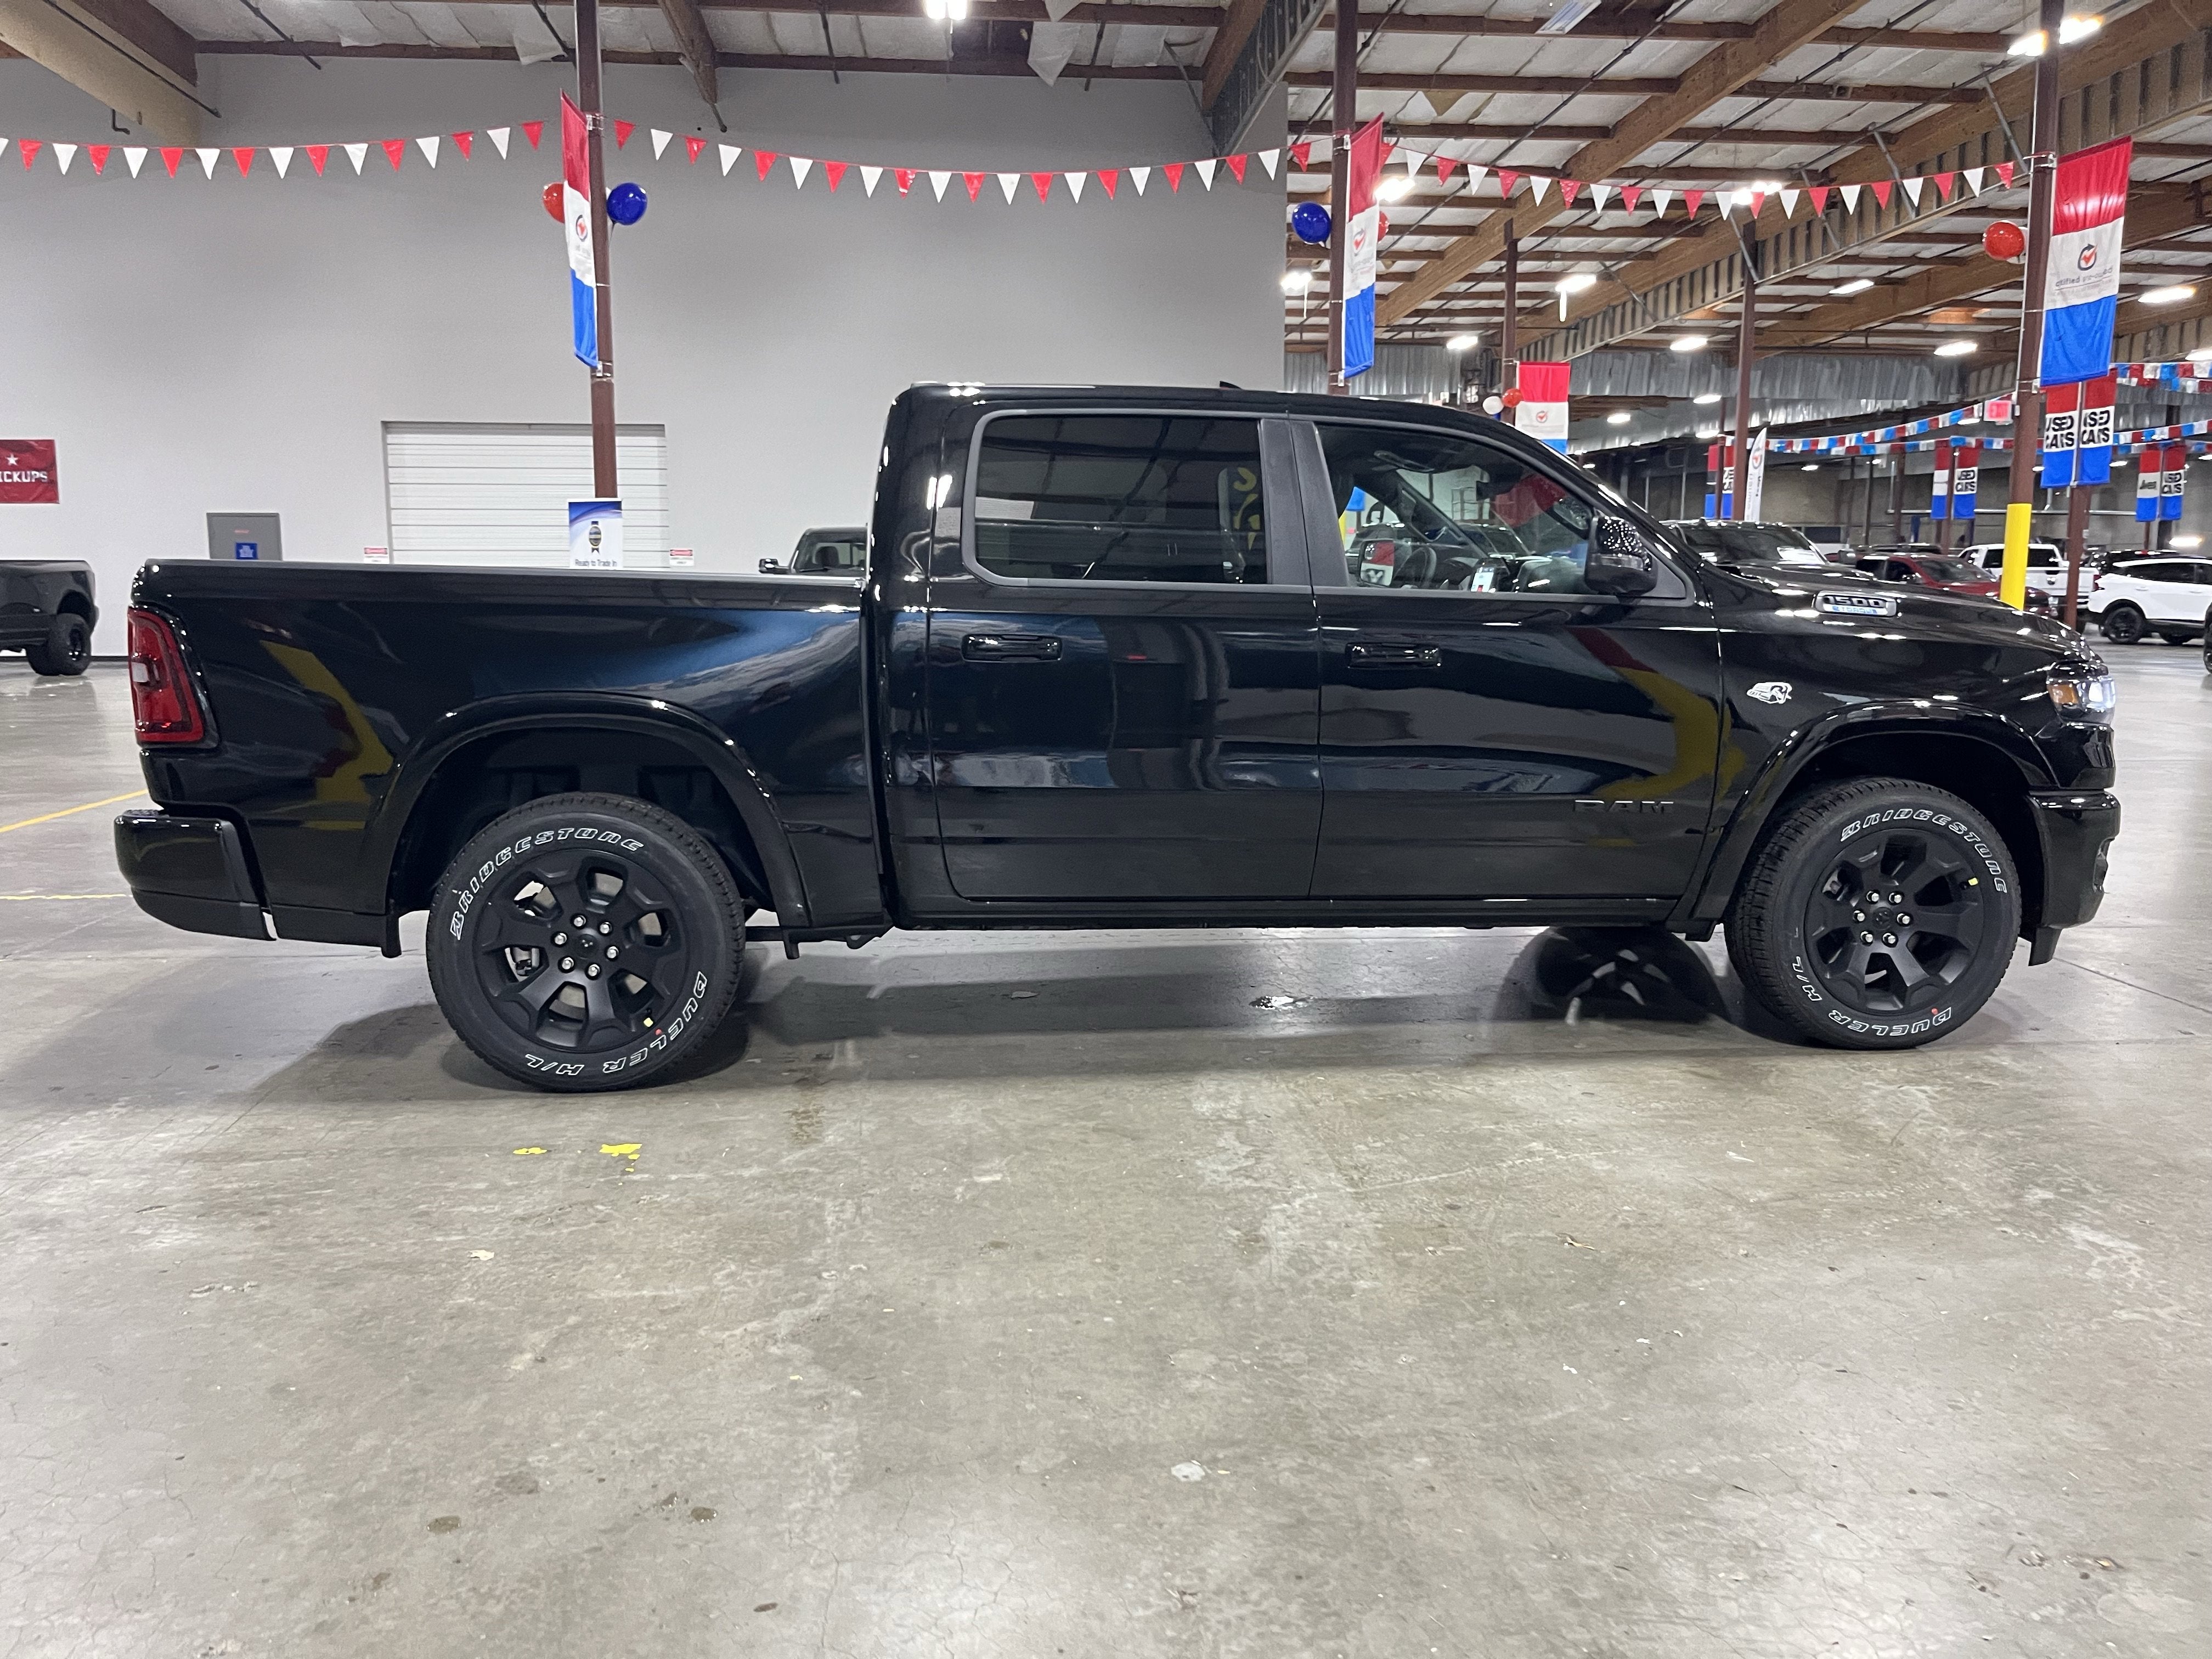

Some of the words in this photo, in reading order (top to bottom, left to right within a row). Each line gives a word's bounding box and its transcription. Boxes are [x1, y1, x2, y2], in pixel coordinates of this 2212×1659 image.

[1823, 596, 1885, 608] 1500
[1841, 809, 2007, 893] BRIDGESTONE
[450, 827, 644, 940] BRIDGESTONE
[1792, 956, 1822, 1001] H/L
[602, 972, 707, 1074] DUELER
[1829, 1007, 1951, 1036] DUELER
[525, 1054, 584, 1075] H/L
